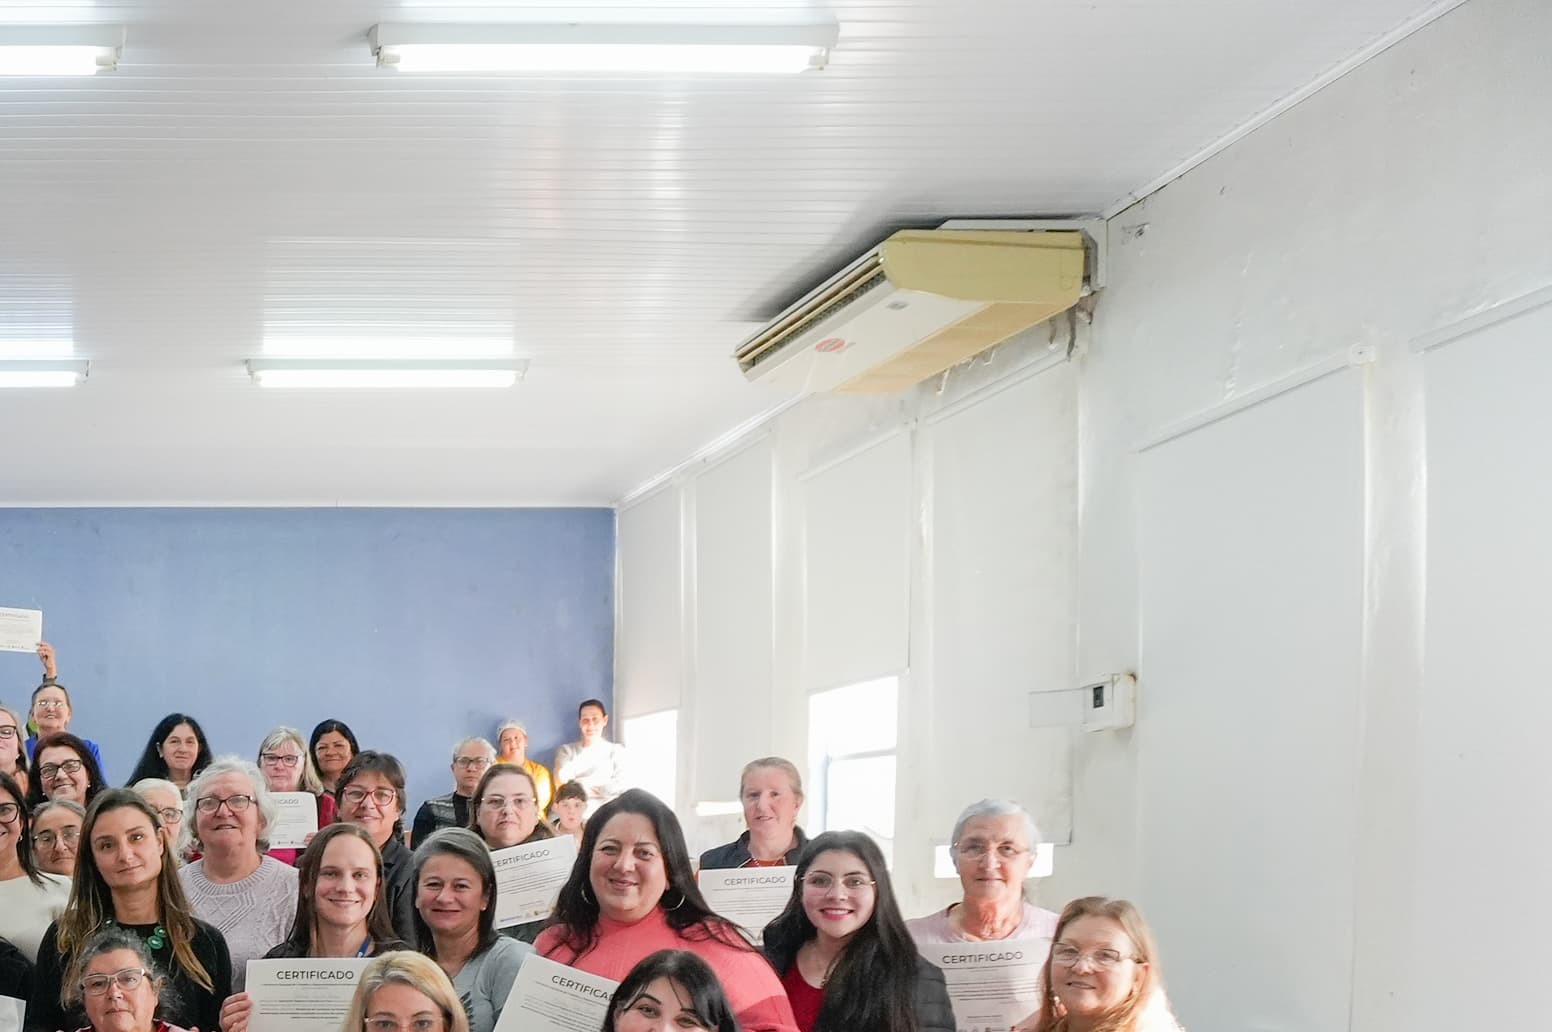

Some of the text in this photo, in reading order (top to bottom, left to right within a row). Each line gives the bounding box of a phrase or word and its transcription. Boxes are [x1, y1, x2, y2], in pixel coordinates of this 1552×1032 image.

[496, 849, 550, 867] ERTIFICADO
[724, 876, 786, 886] CERTIFICADO
[942, 951, 1023, 964] CERTIFICADO
[276, 970, 354, 980] CERTIFICADO
